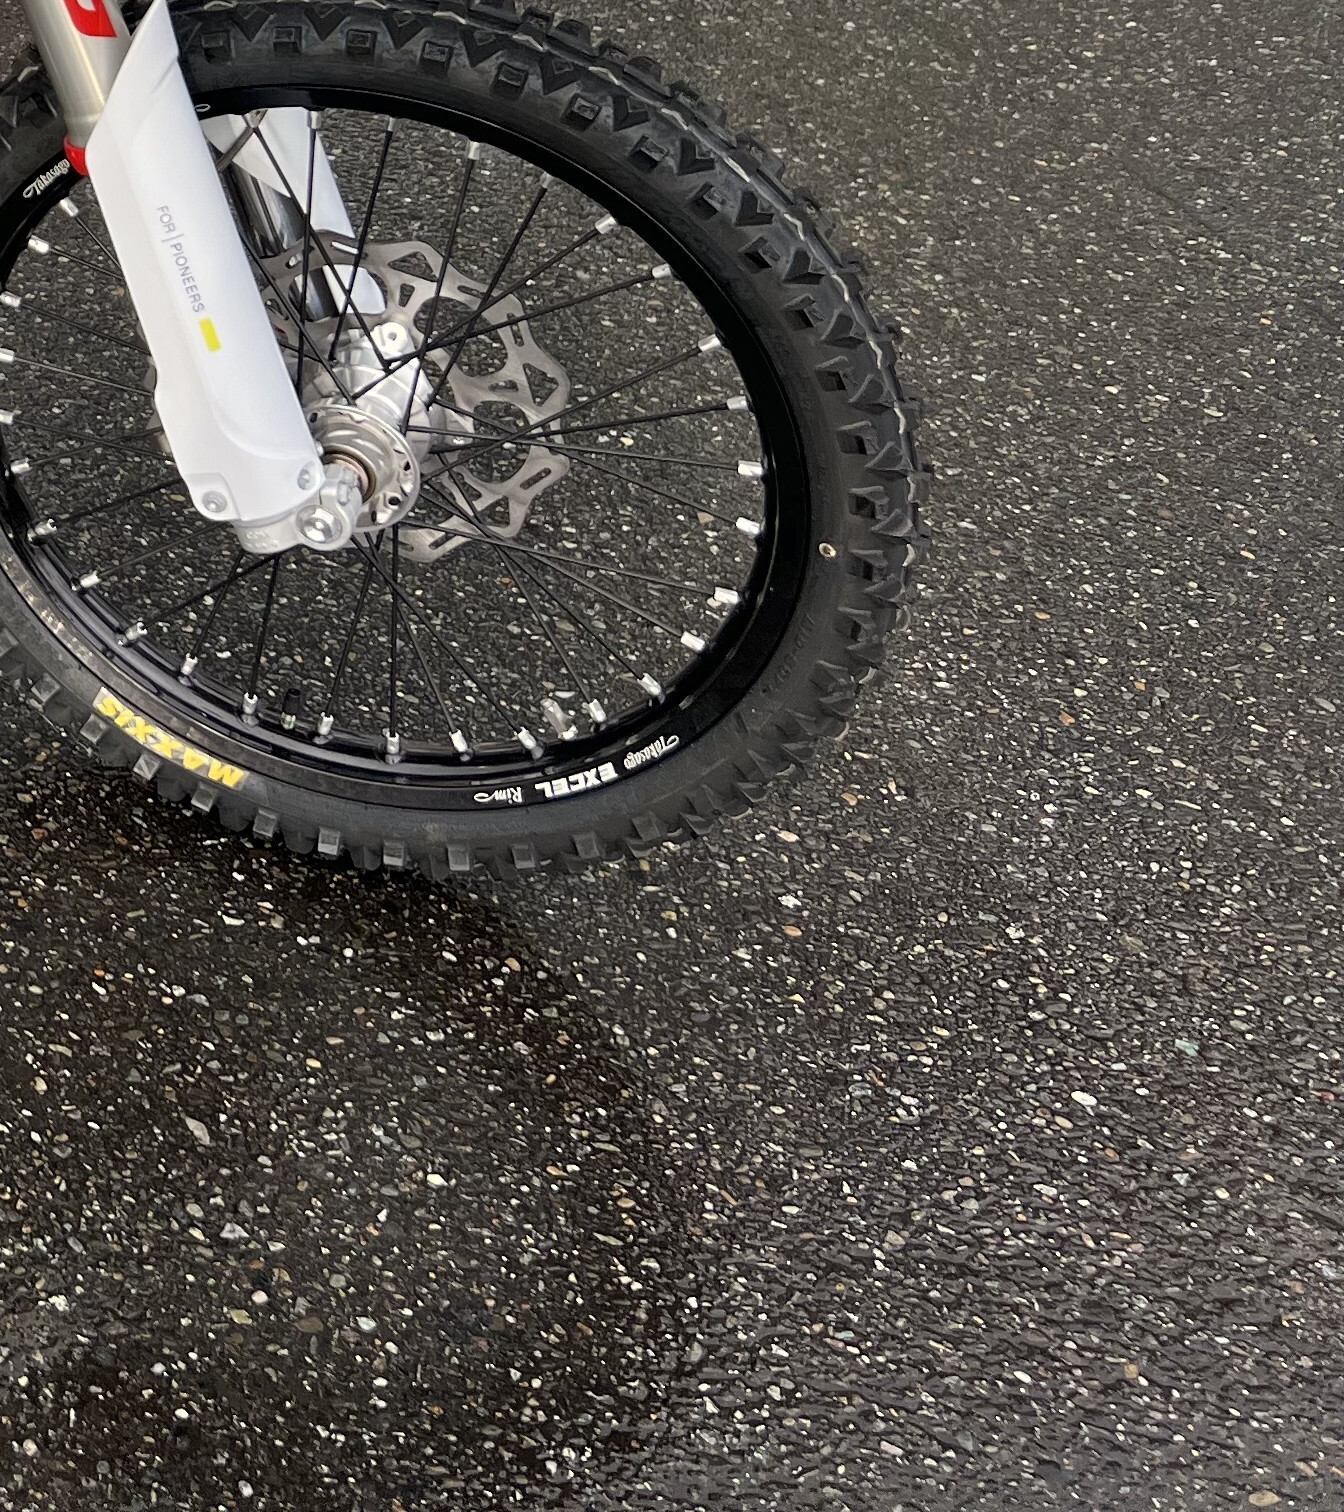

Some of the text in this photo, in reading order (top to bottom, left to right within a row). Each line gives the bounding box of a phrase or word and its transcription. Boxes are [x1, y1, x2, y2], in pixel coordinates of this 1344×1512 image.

[22, 158, 71, 199] Takasago
[156, 205, 205, 314] FOR PIONEERS
[93, 695, 246, 789] MAXXIS
[473, 734, 680, 804] Takasago EXCEL Rim
